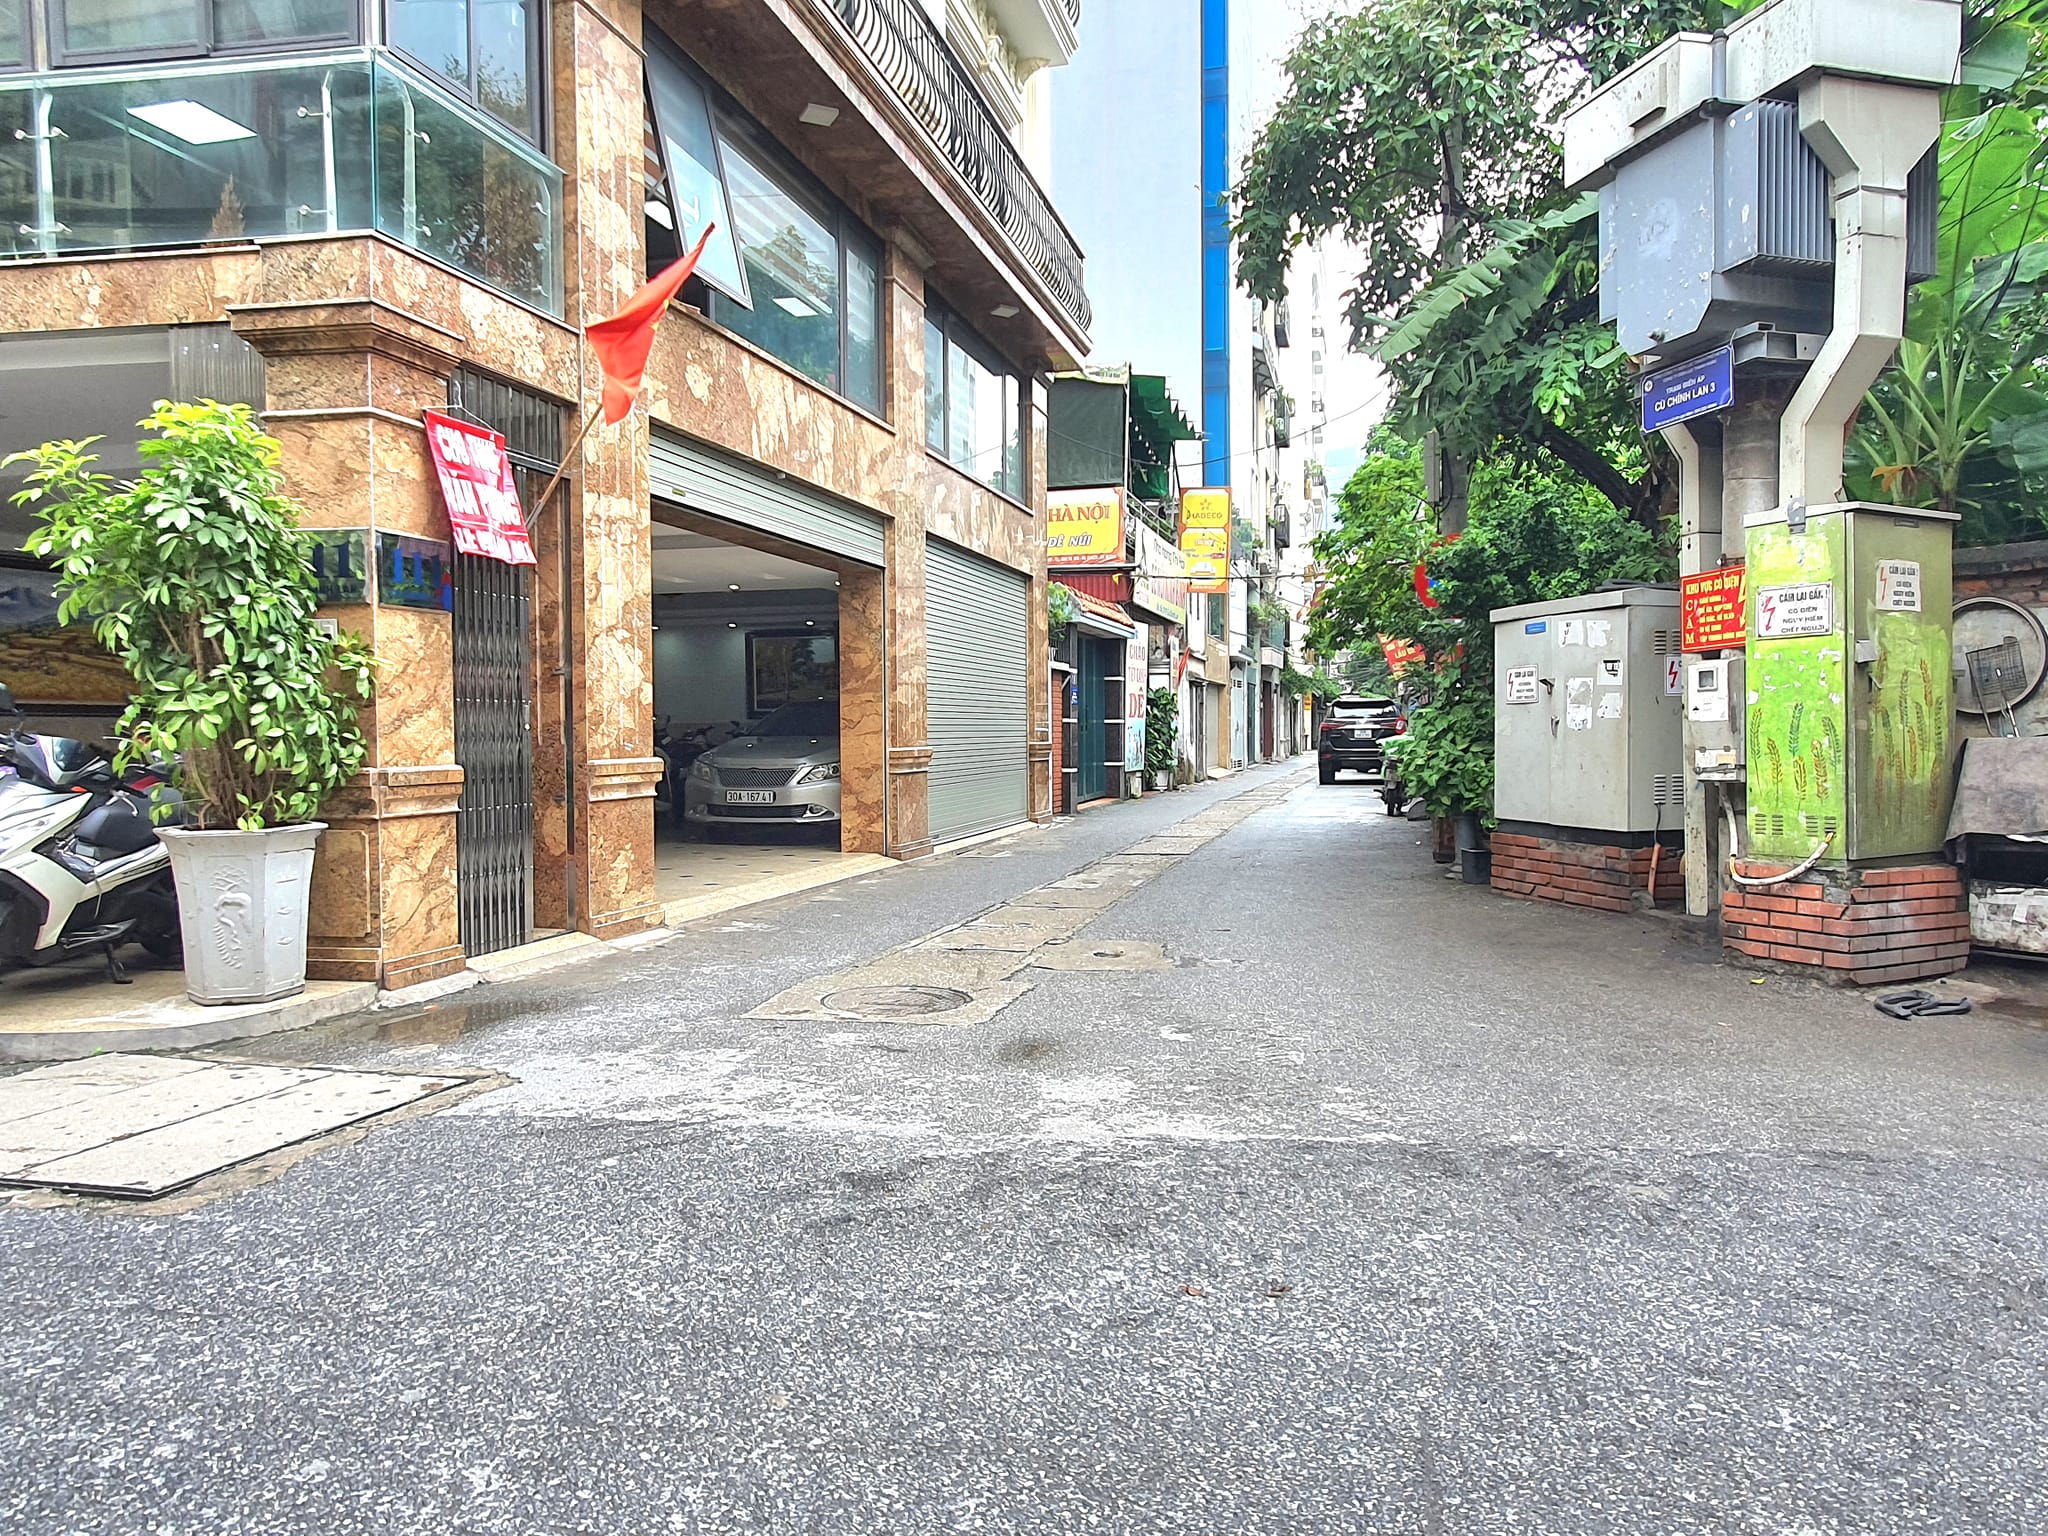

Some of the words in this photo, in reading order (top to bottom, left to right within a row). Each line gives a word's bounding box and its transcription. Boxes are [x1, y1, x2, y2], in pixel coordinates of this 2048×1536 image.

[1667, 391, 1691, 408] CHÍNH
[1692, 384, 1709, 399] LAN
[1709, 381, 1717, 393] 3
[436, 423, 470, 466] CHO
[1048, 503, 1075, 523] HÀ
[1077, 502, 1111, 524] NỘI
[1068, 531, 1093, 547] NÚI
[1685, 583, 1700, 595] KHU
[1128, 686, 1145, 719] DÊ
